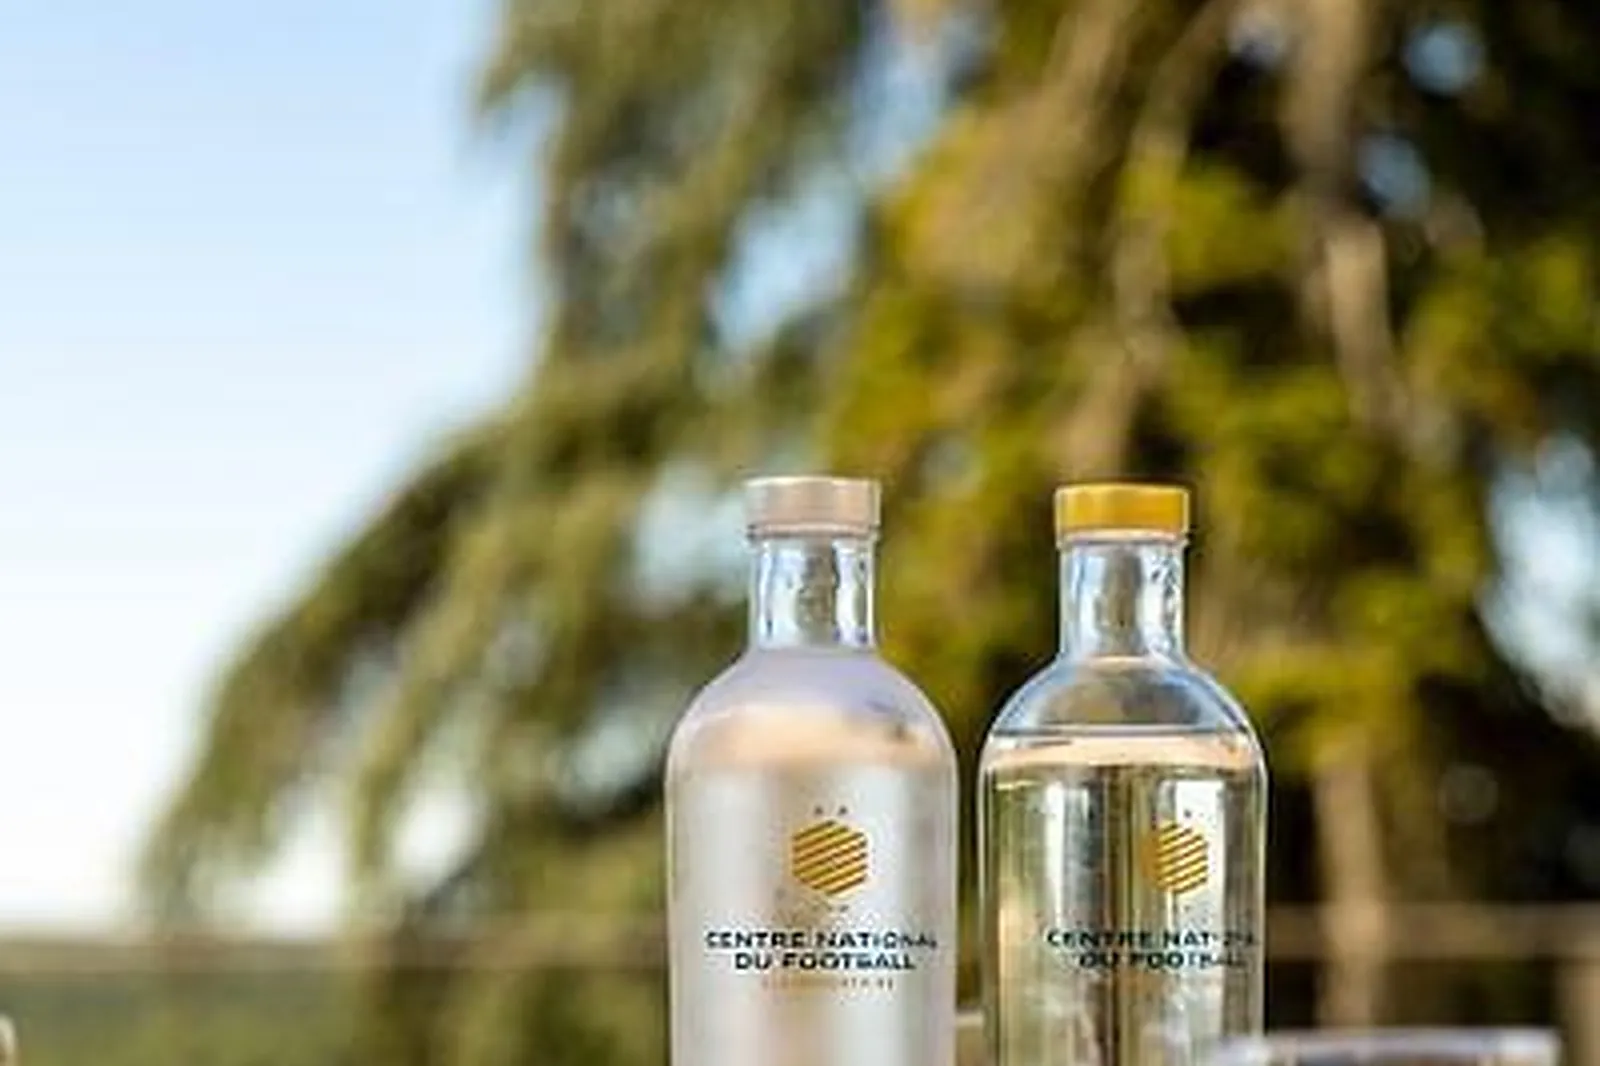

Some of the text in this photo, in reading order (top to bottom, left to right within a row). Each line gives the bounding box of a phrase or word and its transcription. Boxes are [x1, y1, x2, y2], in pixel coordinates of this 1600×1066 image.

[706, 931, 804, 949] CENTRE
[734, 952, 916, 970] DU FOOTBALL
